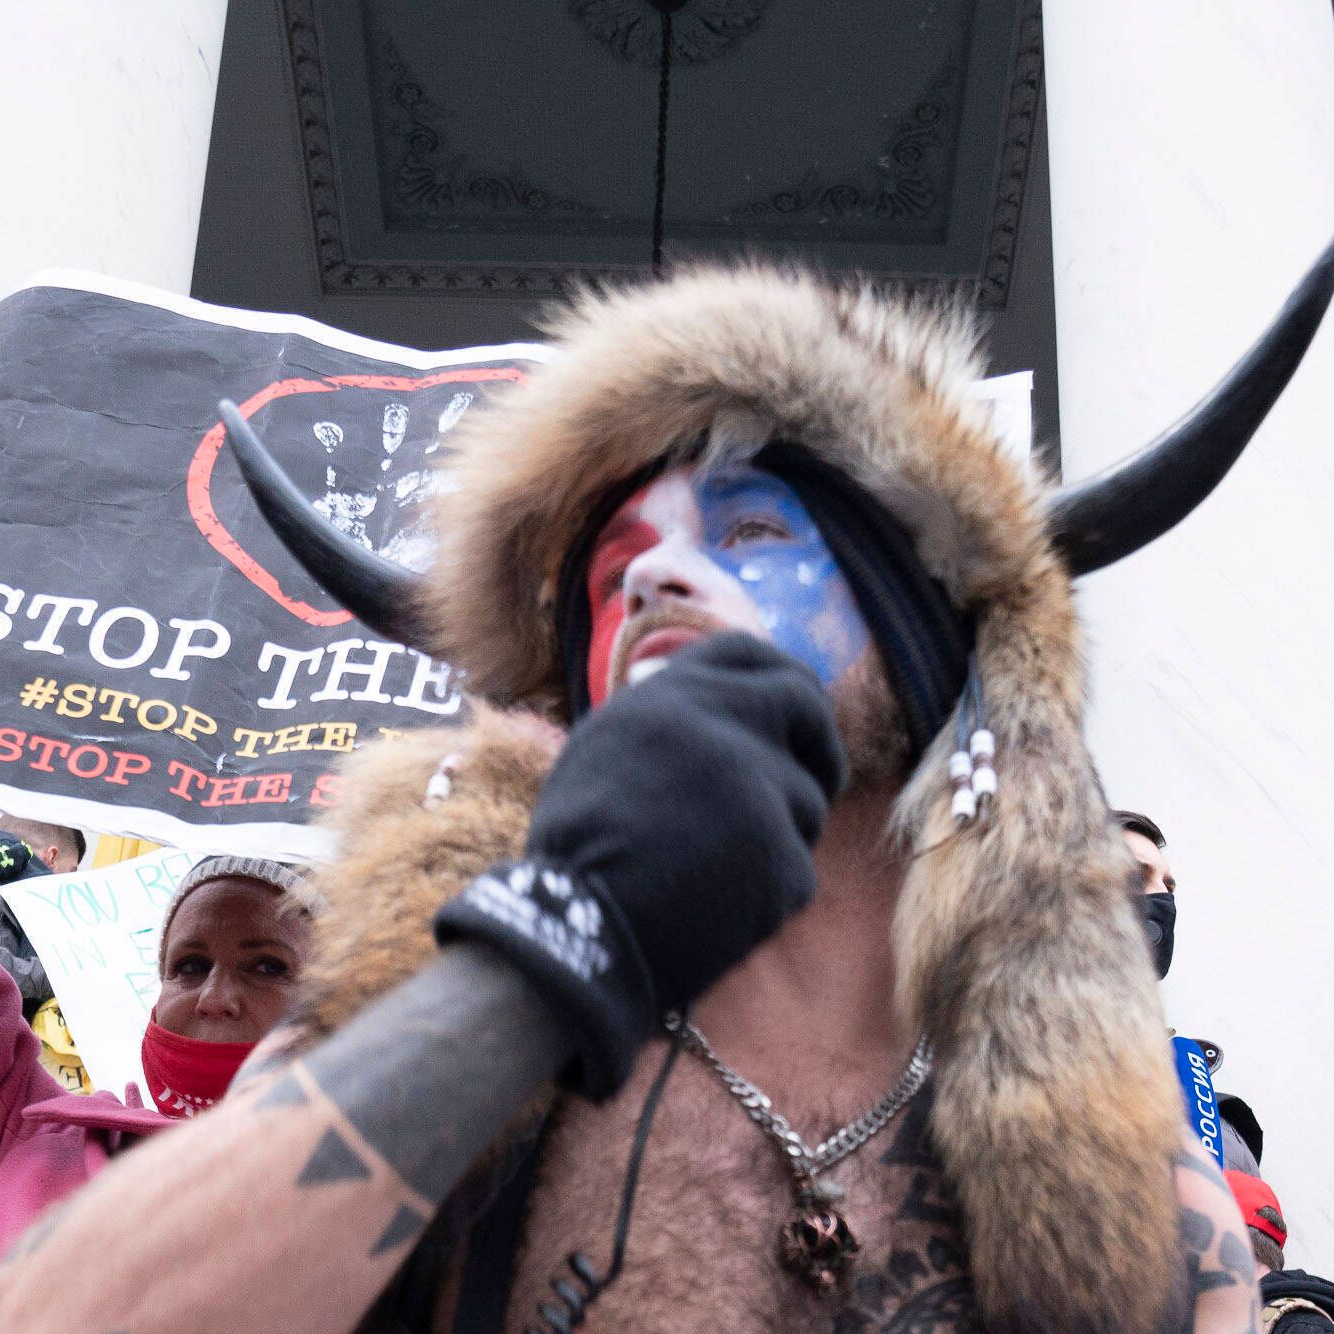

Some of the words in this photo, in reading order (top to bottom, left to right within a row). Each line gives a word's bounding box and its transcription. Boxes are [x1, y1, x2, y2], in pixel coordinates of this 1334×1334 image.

[257, 638, 464, 715] THE
[19, 676, 218, 742] #STOP
[233, 722, 358, 759] THE
[168, 760, 293, 807] THE
[26, 879, 120, 931] YOU
[1187, 1052, 1220, 1157] РОССИЯ
